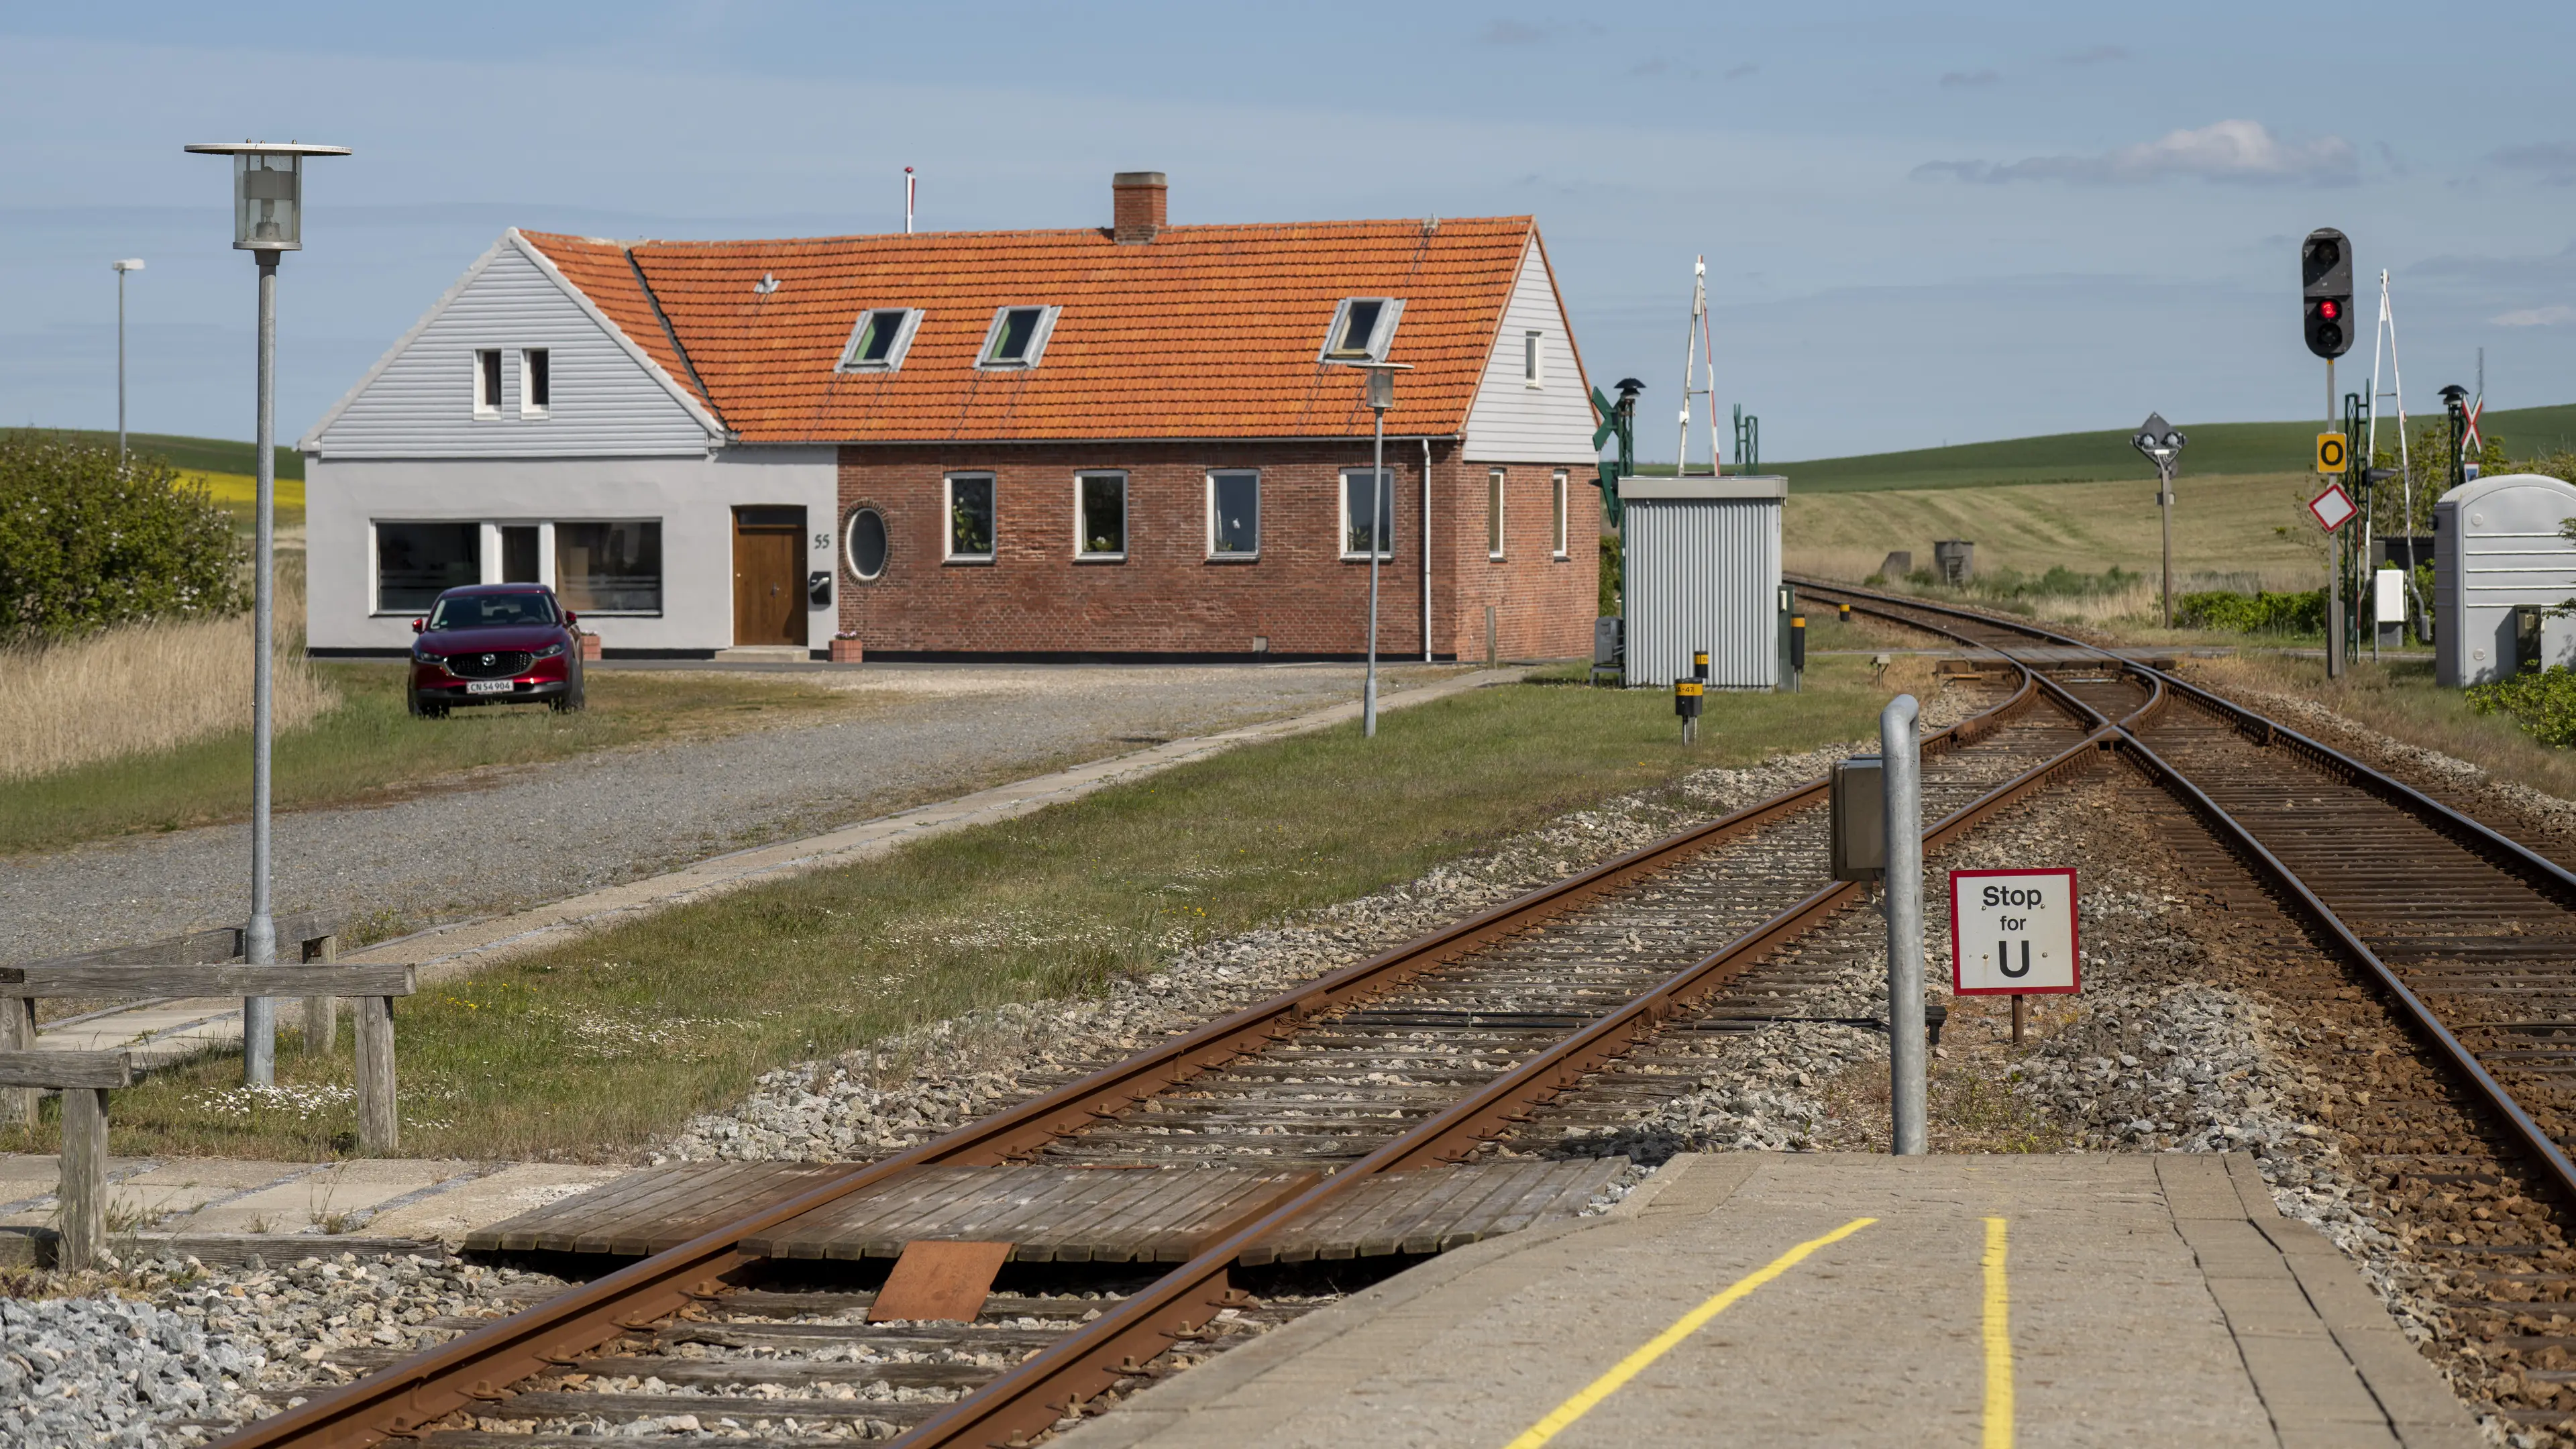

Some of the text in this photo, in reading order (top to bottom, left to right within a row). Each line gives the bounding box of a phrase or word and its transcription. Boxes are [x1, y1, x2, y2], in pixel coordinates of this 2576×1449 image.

[814, 534, 830, 549] 55
[1983, 885, 2041, 910] Stop
[2000, 915, 2027, 931] for
[1998, 940, 2030, 978] U
